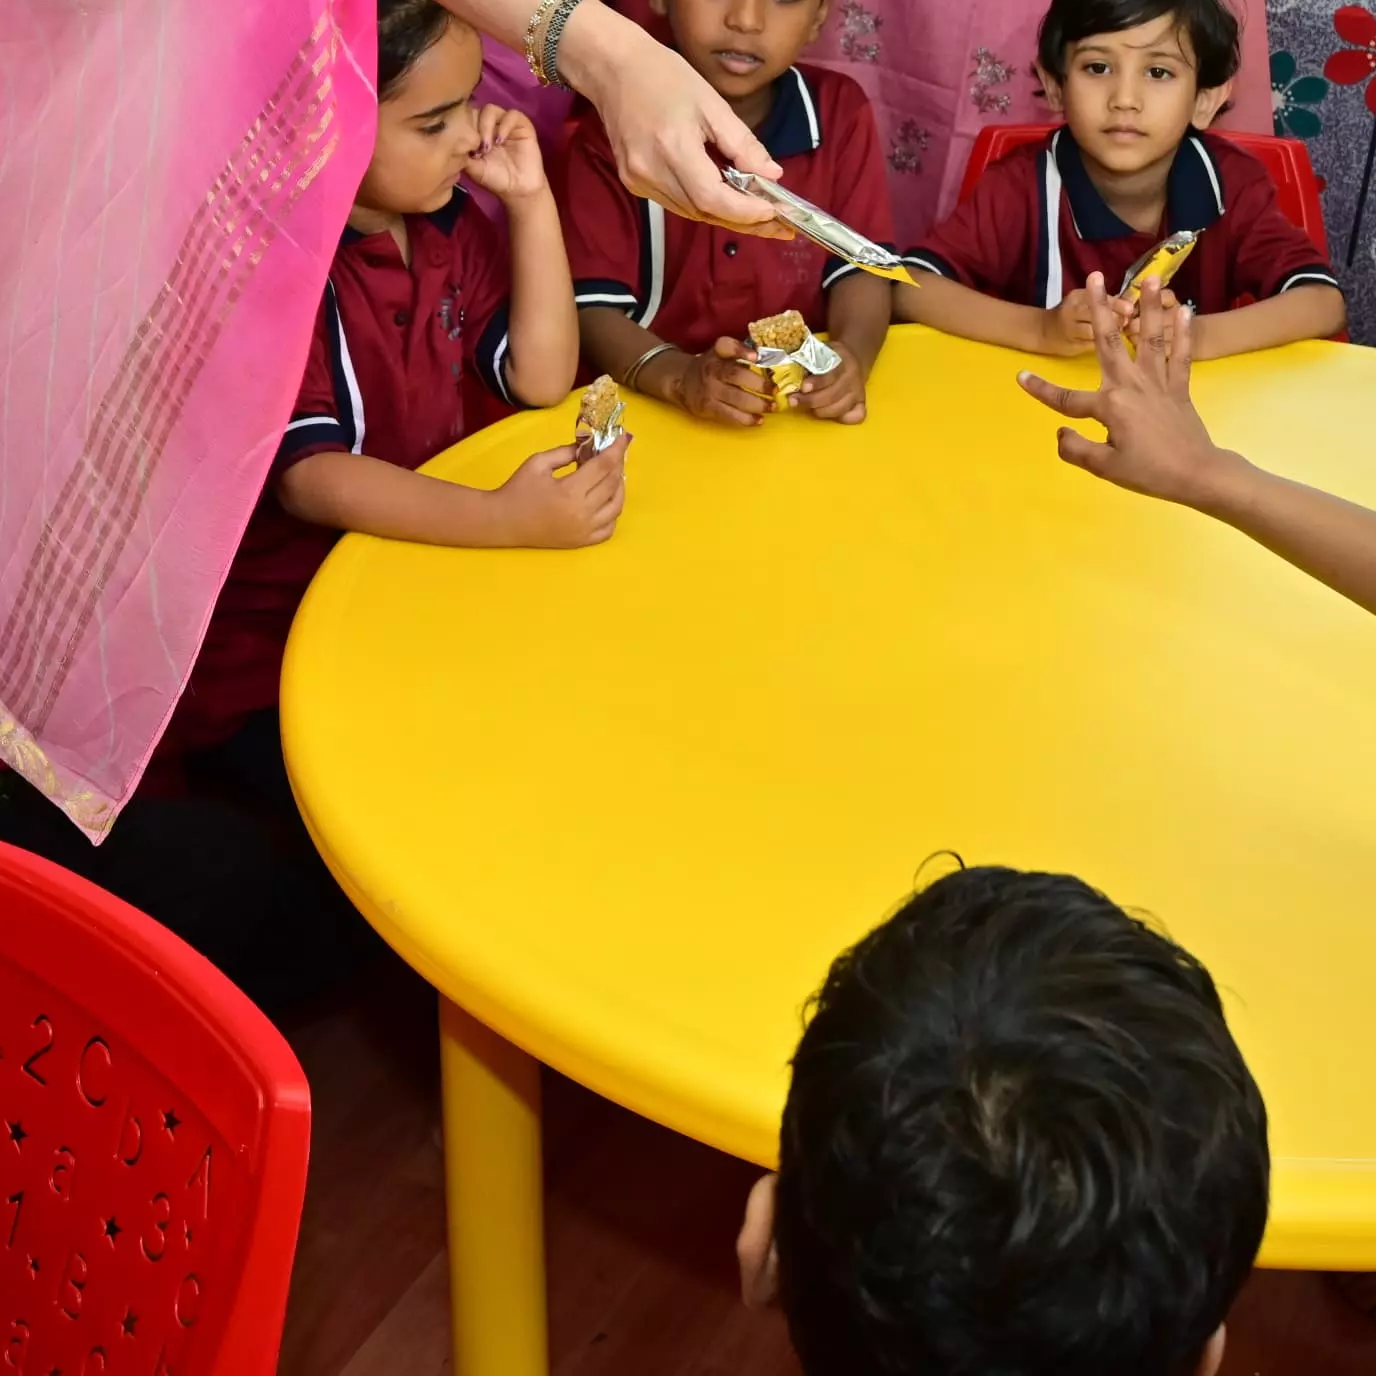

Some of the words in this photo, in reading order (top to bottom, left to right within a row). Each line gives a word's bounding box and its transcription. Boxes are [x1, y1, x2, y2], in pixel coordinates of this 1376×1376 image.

[20, 1013, 54, 1086] 2
[75, 1034, 113, 1108] C
[6, 1189, 25, 1250] 1
[139, 1191, 172, 1262] 3
